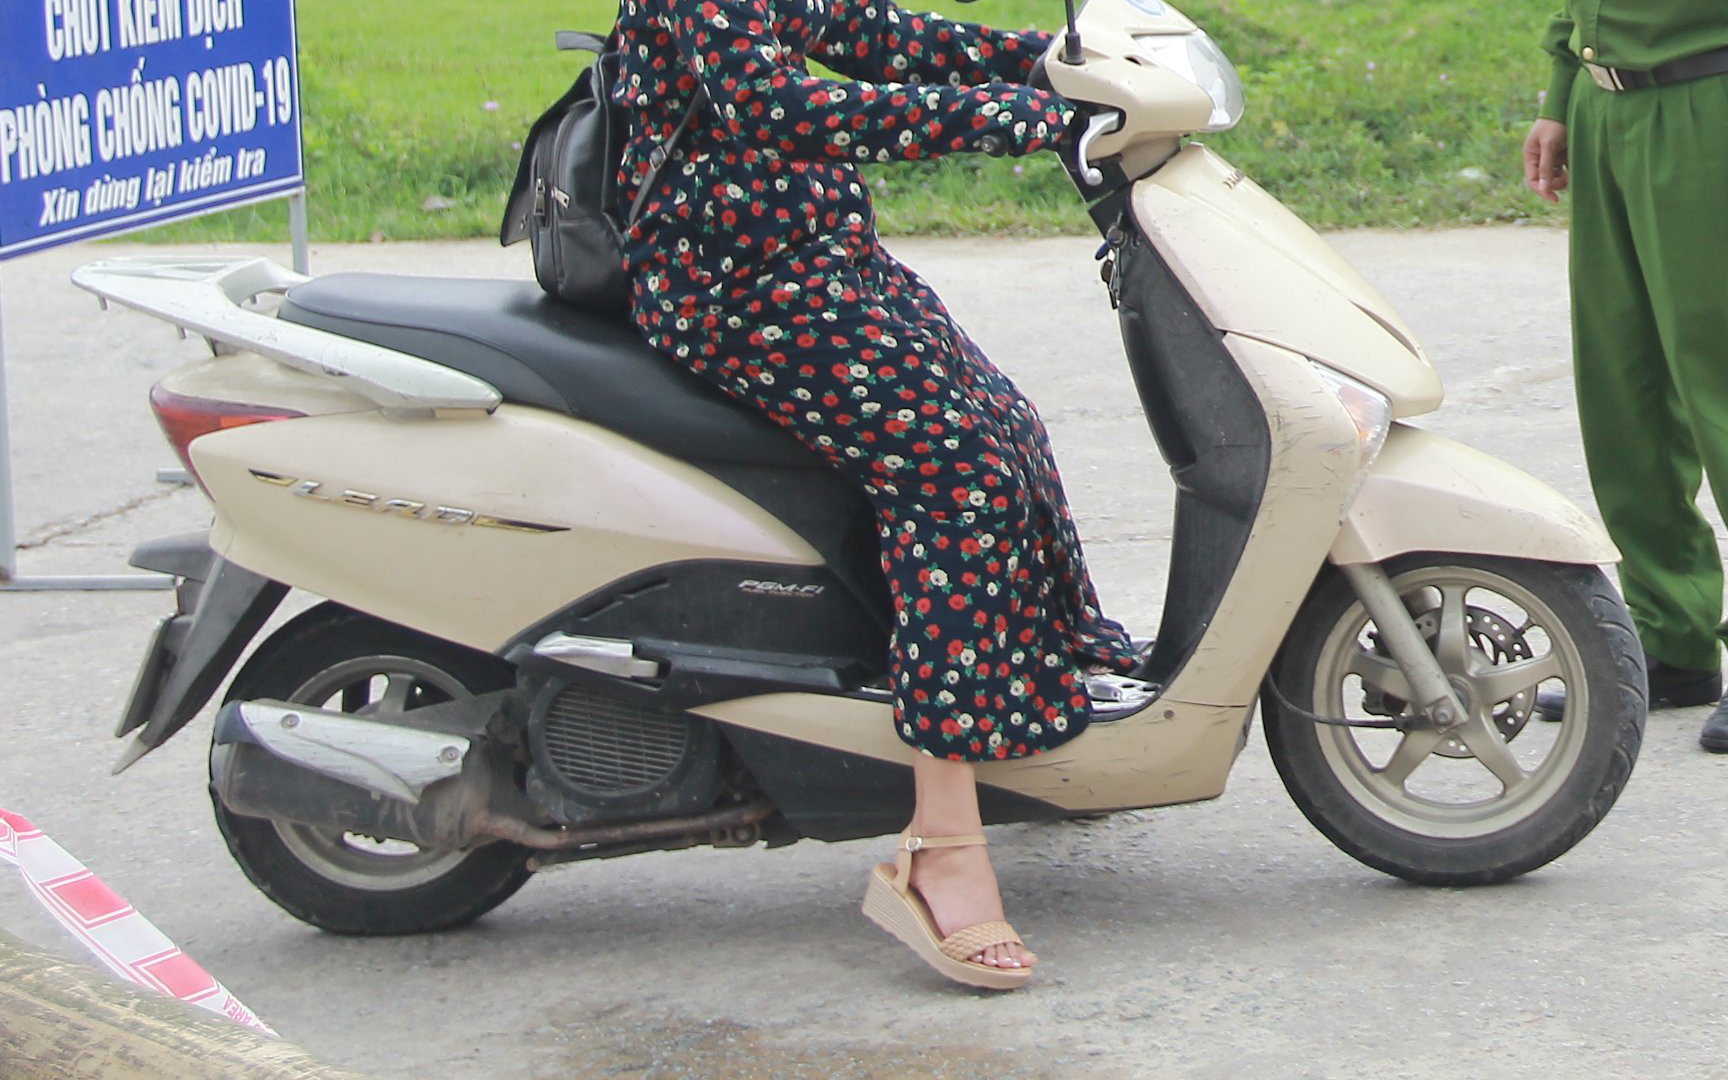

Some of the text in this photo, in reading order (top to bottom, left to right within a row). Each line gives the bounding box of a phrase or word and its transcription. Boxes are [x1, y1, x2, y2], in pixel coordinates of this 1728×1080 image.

[0, 56, 292, 185] PHÒNG CHỐNG COVID-19
[39, 146, 267, 227] Xin dừng lại kiểm tra
[293, 480, 474, 525] LEAD
